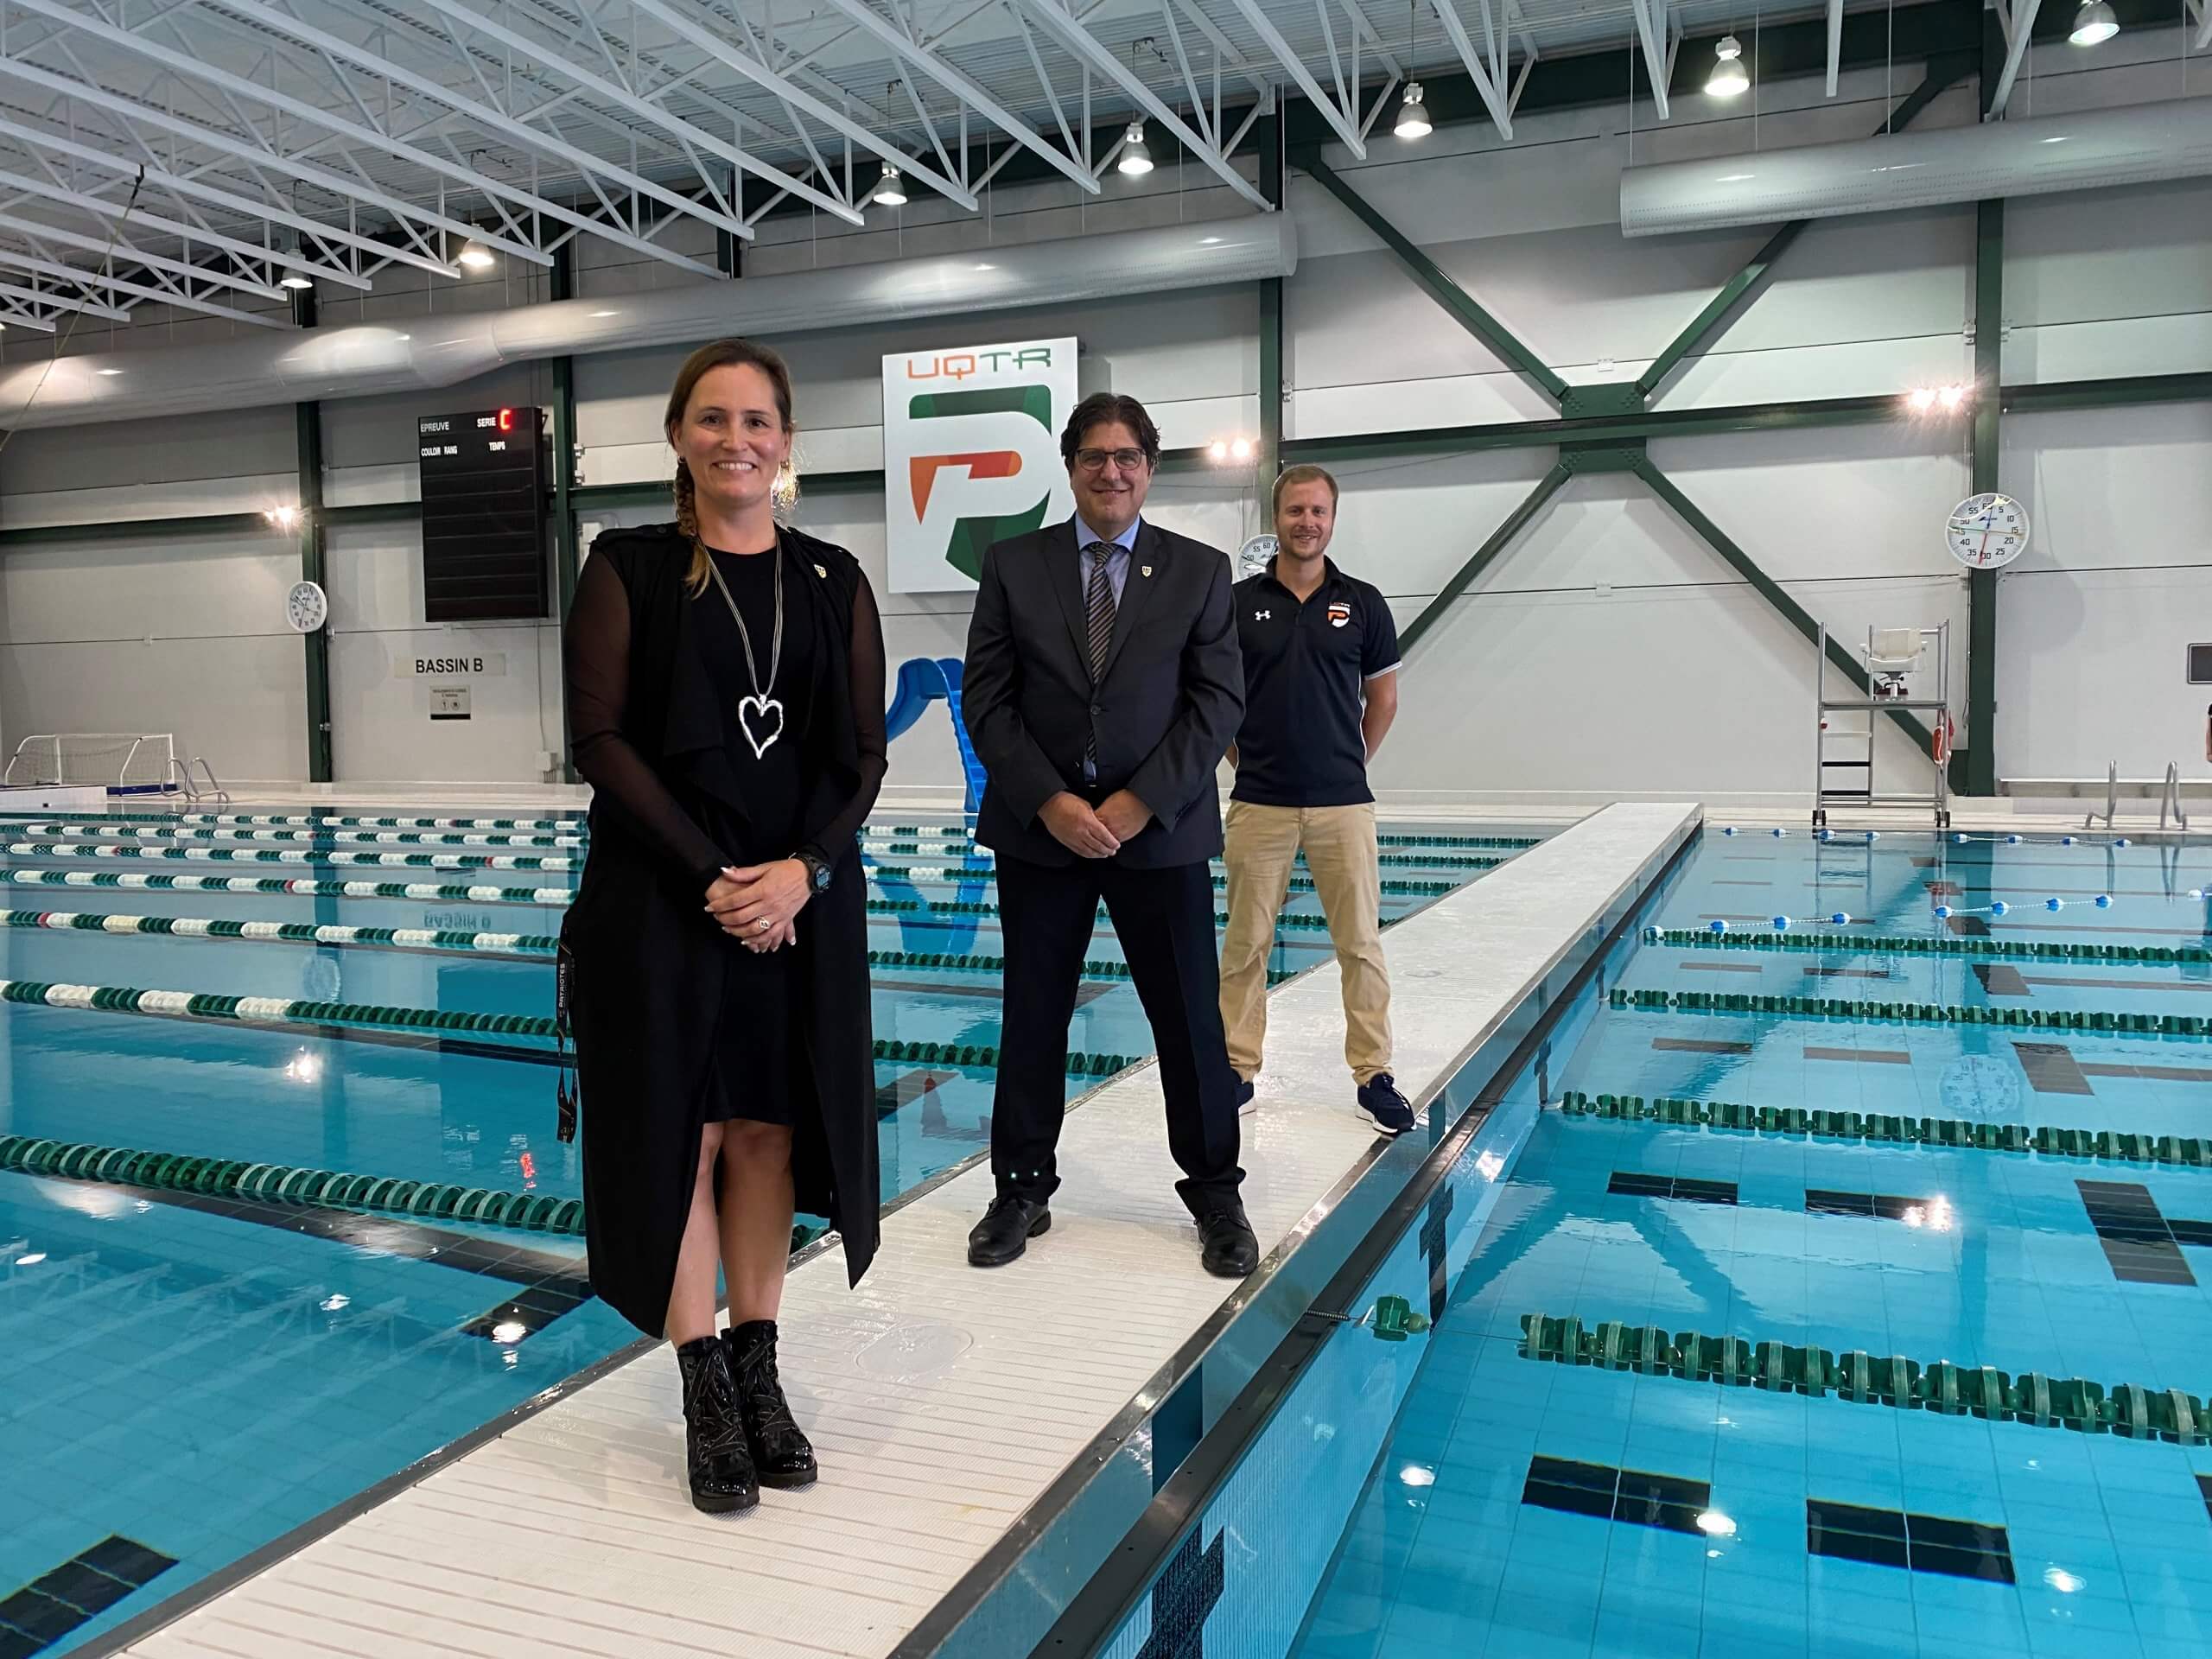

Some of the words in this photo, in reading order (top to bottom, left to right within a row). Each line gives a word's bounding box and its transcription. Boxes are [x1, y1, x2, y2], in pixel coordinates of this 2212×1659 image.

[907, 347, 1051, 380] UQTR
[416, 658, 468, 673] BASSIN
[474, 658, 483, 672] B
